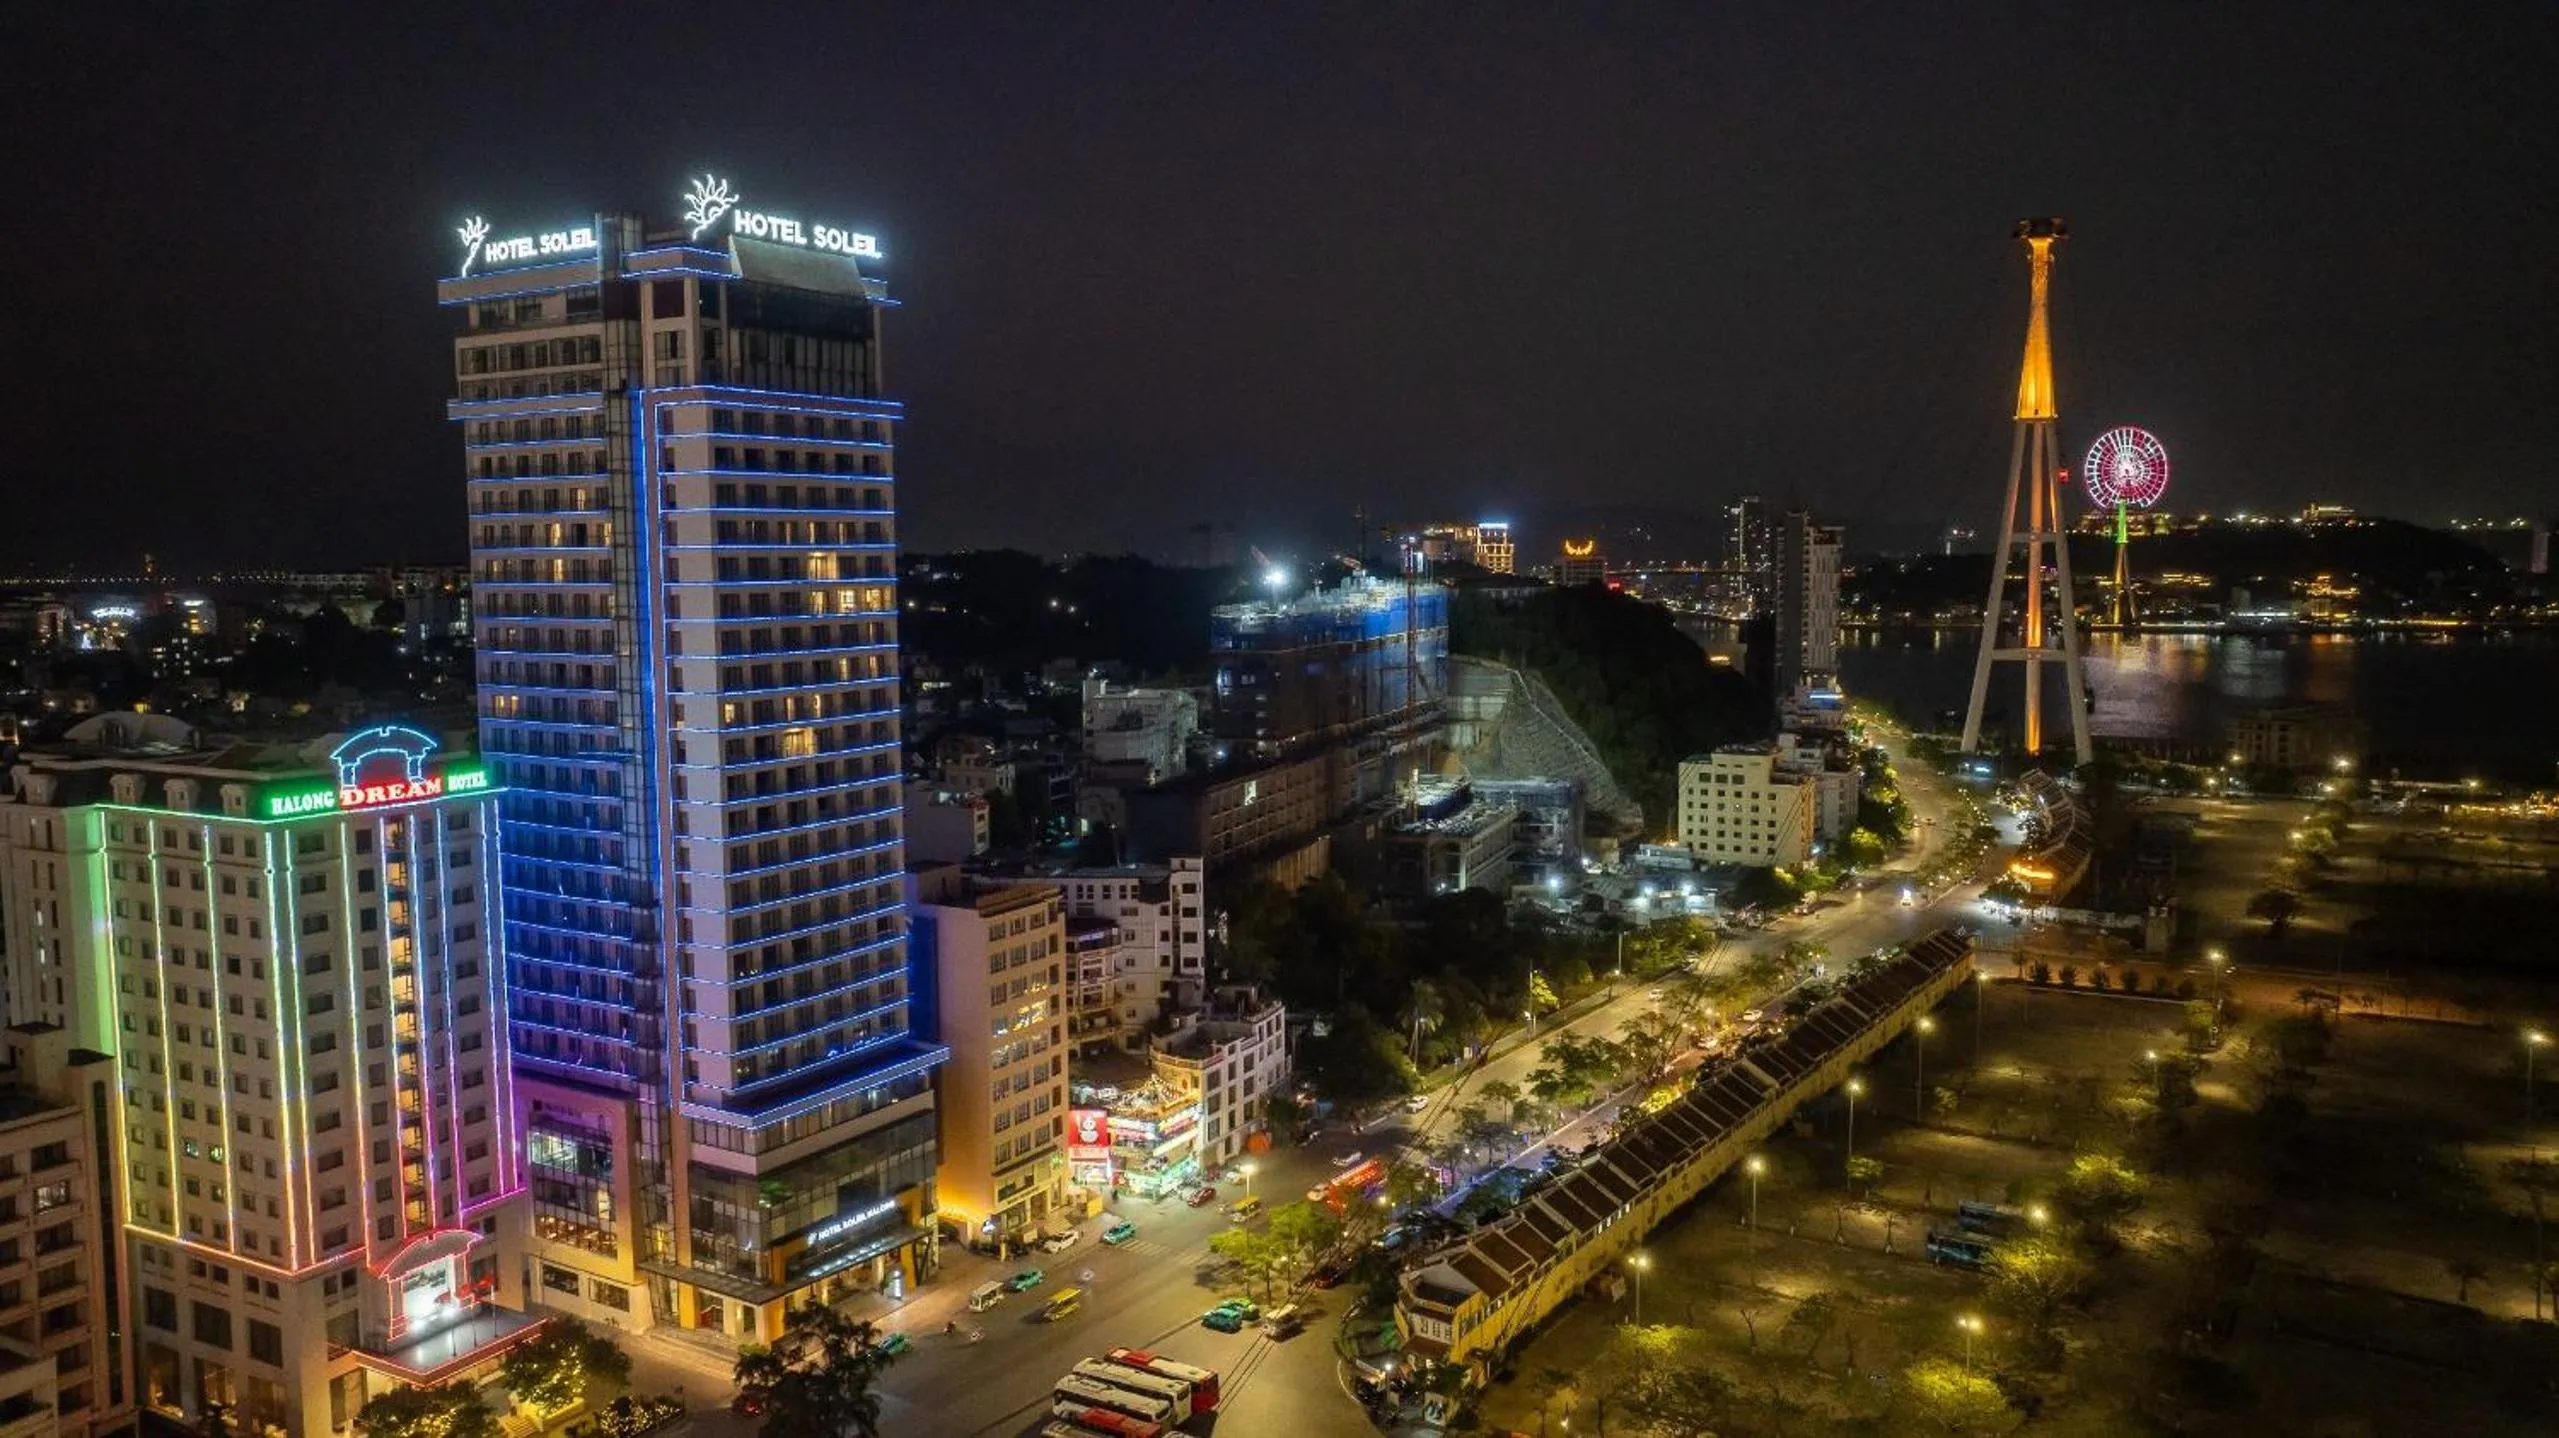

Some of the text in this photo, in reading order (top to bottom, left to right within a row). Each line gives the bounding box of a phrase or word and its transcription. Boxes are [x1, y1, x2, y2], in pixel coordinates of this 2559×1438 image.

[485, 228, 597, 263] HOTEL SOLEIL
[735, 208, 883, 259] HOTEL SOLEIL
[271, 771, 487, 815] HALONG DREAM HOTEL
